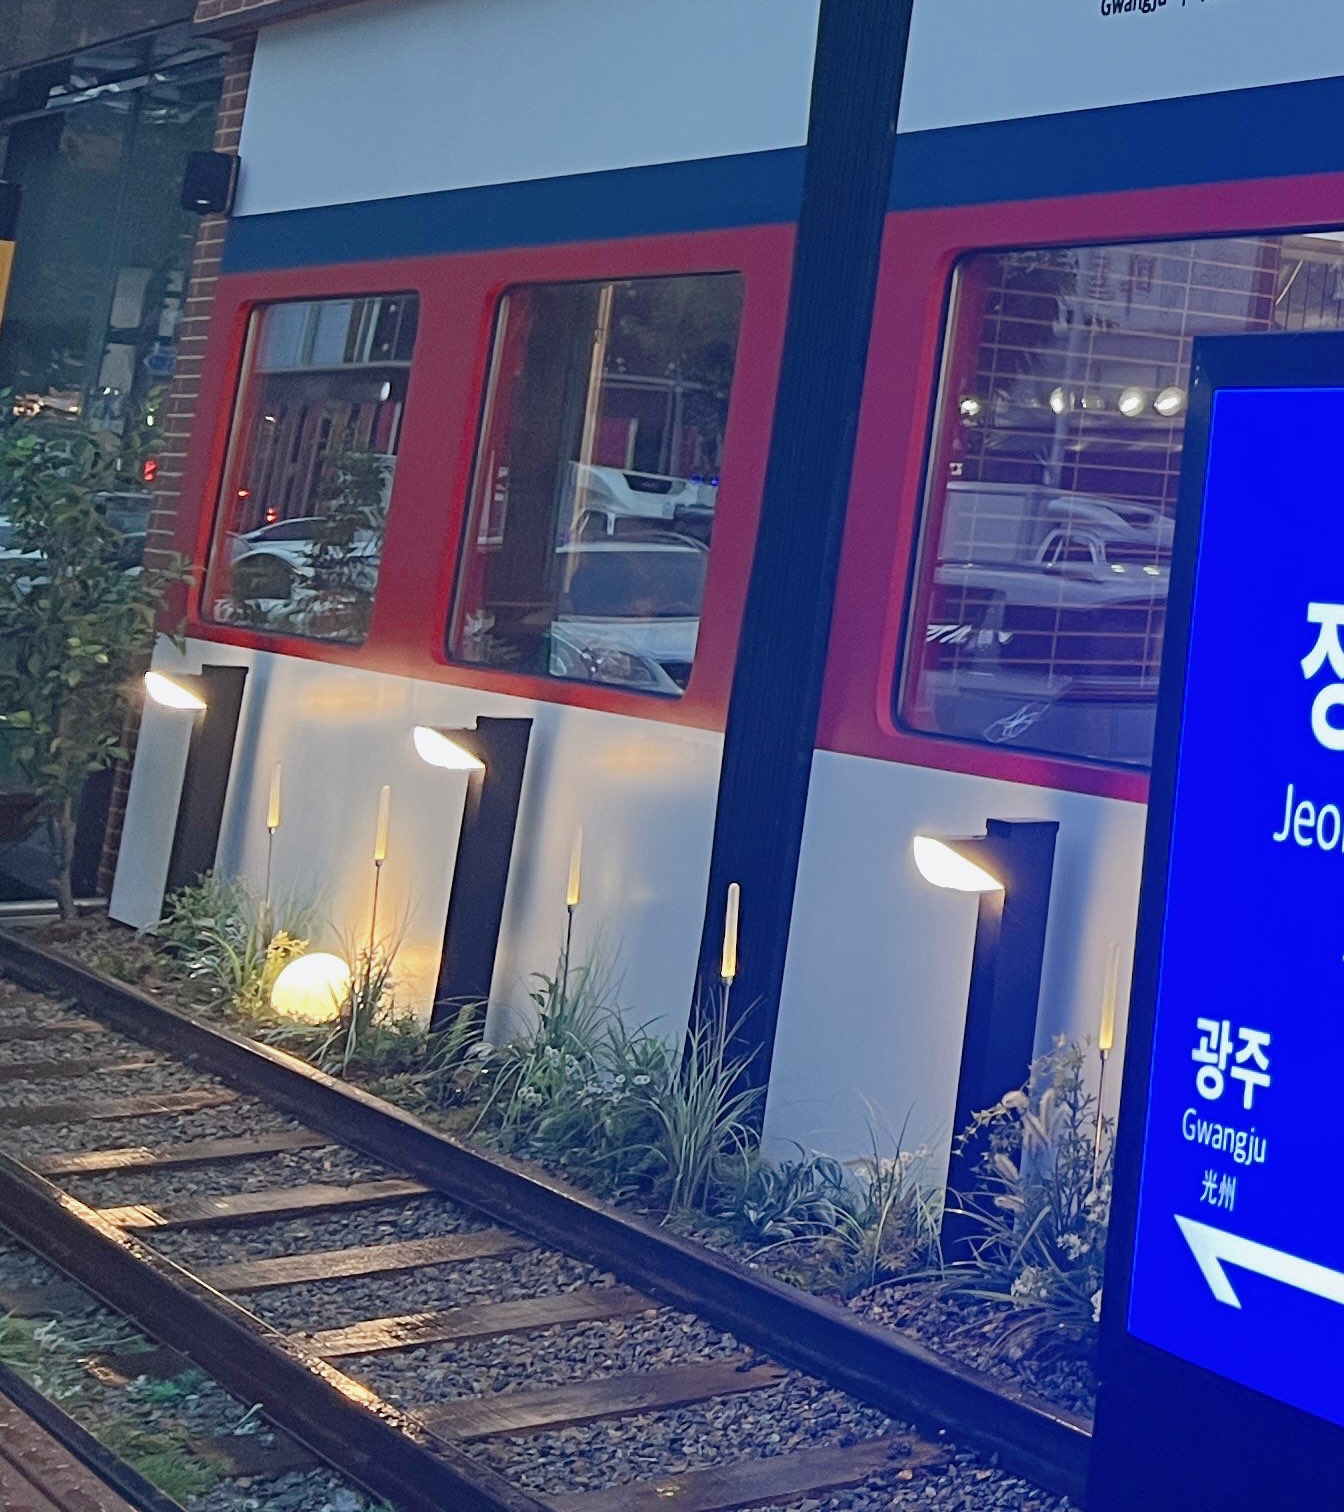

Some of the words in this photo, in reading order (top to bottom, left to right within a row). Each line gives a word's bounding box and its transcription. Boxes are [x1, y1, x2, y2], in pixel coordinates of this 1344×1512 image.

[1191, 1016, 1272, 1110] 광주
[1181, 1107, 1267, 1166] Gwangju
[1200, 1169, 1237, 1212] 光州
